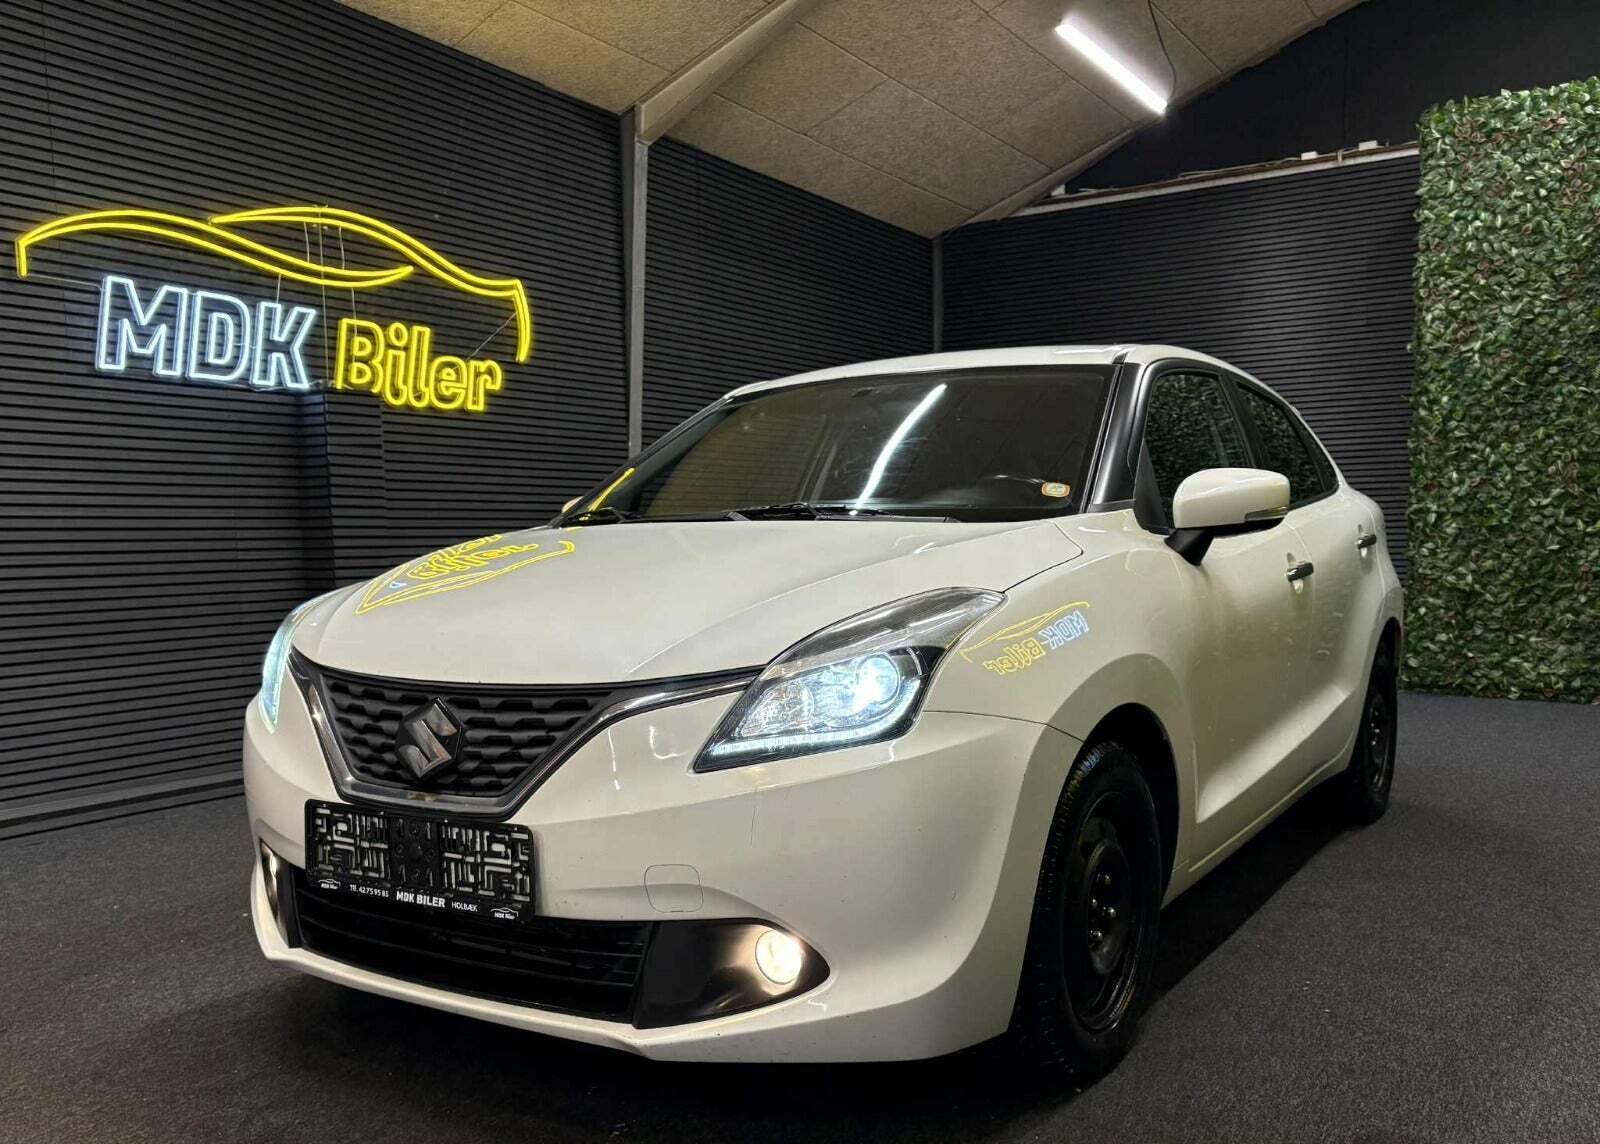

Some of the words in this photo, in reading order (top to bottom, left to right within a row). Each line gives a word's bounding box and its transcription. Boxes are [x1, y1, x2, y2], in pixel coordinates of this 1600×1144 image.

[95, 274, 316, 391] MDK
[334, 317, 503, 412] Biler
[396, 890, 415, 903] MDK
[416, 894, 446, 908] BILER
